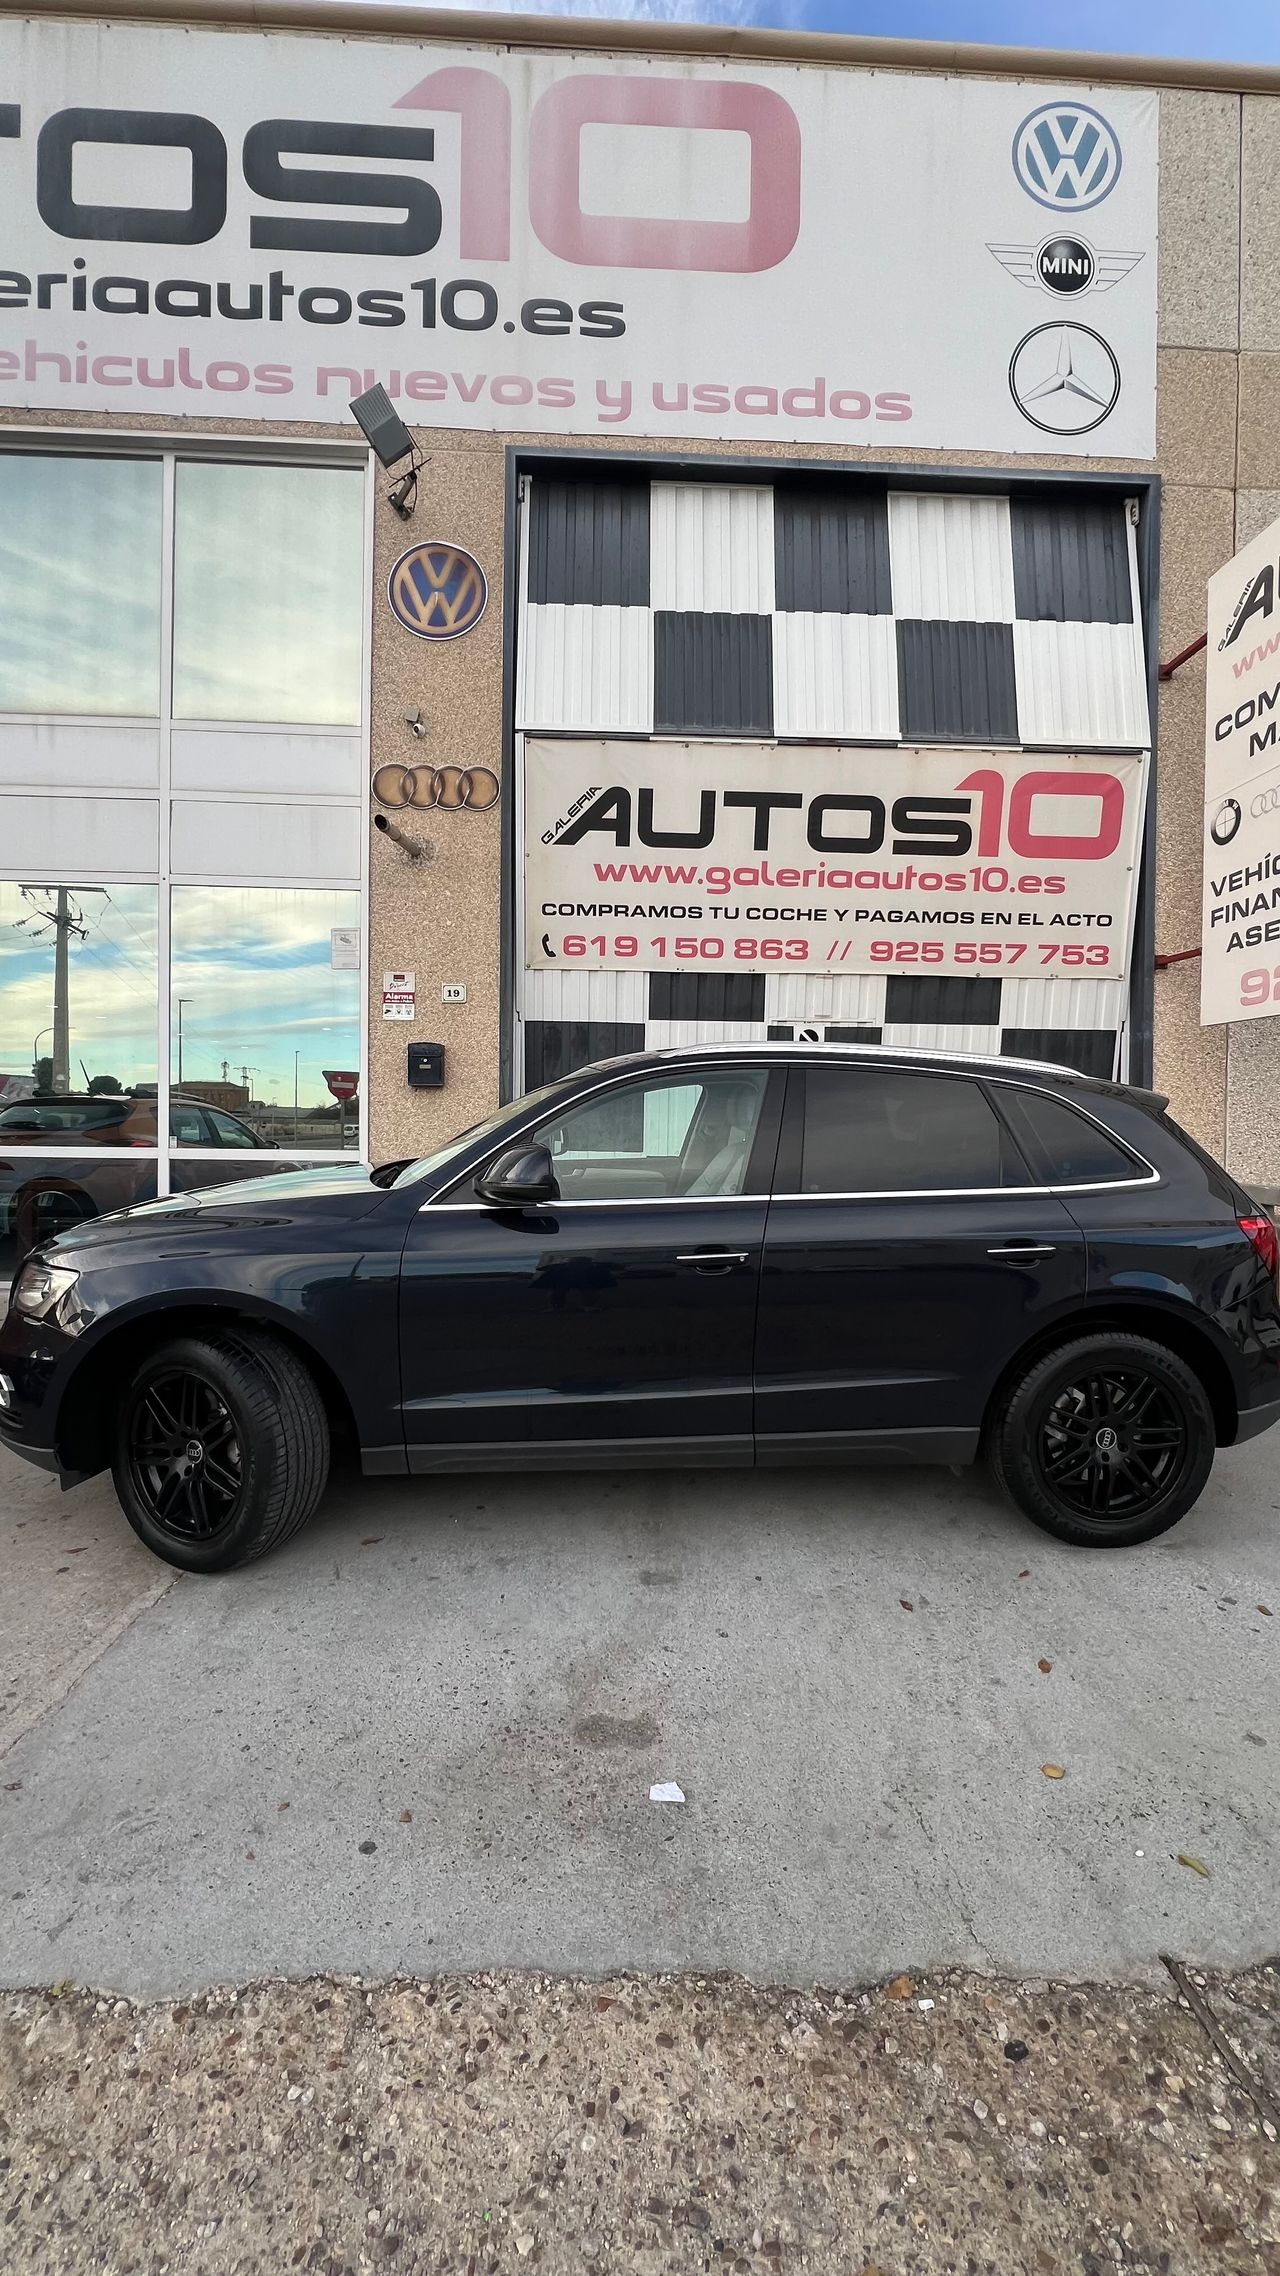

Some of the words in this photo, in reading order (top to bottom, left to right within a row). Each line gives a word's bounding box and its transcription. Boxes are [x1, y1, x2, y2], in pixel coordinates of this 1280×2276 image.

[0, 66, 801, 273] OS10
[1042, 256, 1089, 275] MINI
[316, 366, 576, 408] nuevos
[595, 379, 632, 422] y
[652, 377, 913, 422] usados
[1224, 564, 1280, 649] A
[1249, 721, 1280, 757] M
[540, 786, 603, 845] GALERIA
[552, 769, 1125, 860] AUTOS10
[592, 861, 1067, 896] www.galeriaautos10.es
[541, 903, 703, 919] COMPRAMOS
[708, 906, 740, 920] TU
[746, 907, 828, 922] COCHE
[833, 909, 850, 922] Y
[854, 909, 975, 925] PAGAMOS
[980, 912, 1012, 925] EN
[1017, 912, 1044, 926] EL
[1048, 913, 1113, 927] ACTO
[562, 934, 639, 958] 619
[650, 936, 725, 960] 150
[733, 938, 810, 961] 863
[869, 940, 945, 964] 925
[953, 942, 1028, 965] 557
[1038, 943, 1110, 967] 753
[385, 992, 413, 1000] Alarma
[446, 989, 460, 998] 19
[1239, 964, 1280, 1006] 9
